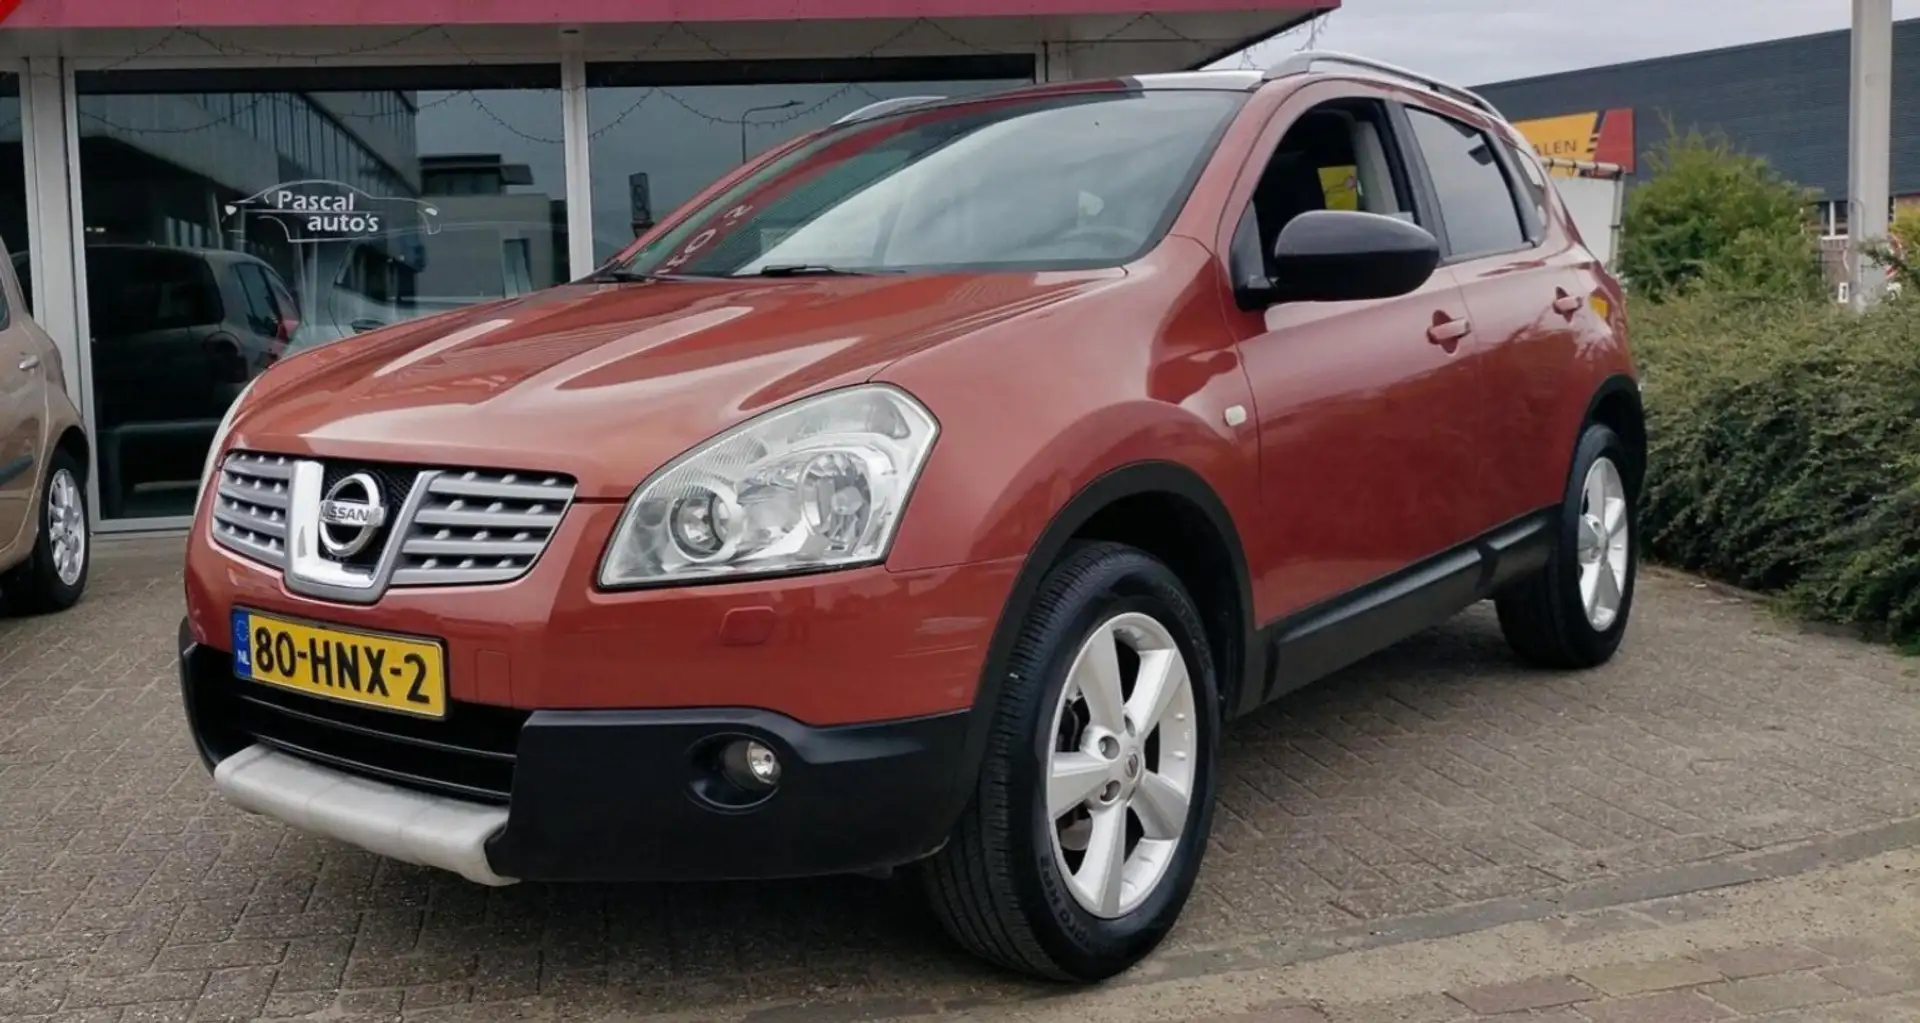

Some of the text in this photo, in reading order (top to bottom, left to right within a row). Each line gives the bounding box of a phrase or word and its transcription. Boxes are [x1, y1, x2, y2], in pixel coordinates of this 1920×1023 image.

[277, 190, 354, 211] Pascal
[307, 213, 380, 232] auto's
[237, 649, 250, 666] NL
[254, 626, 430, 704] 80-HNX-2
